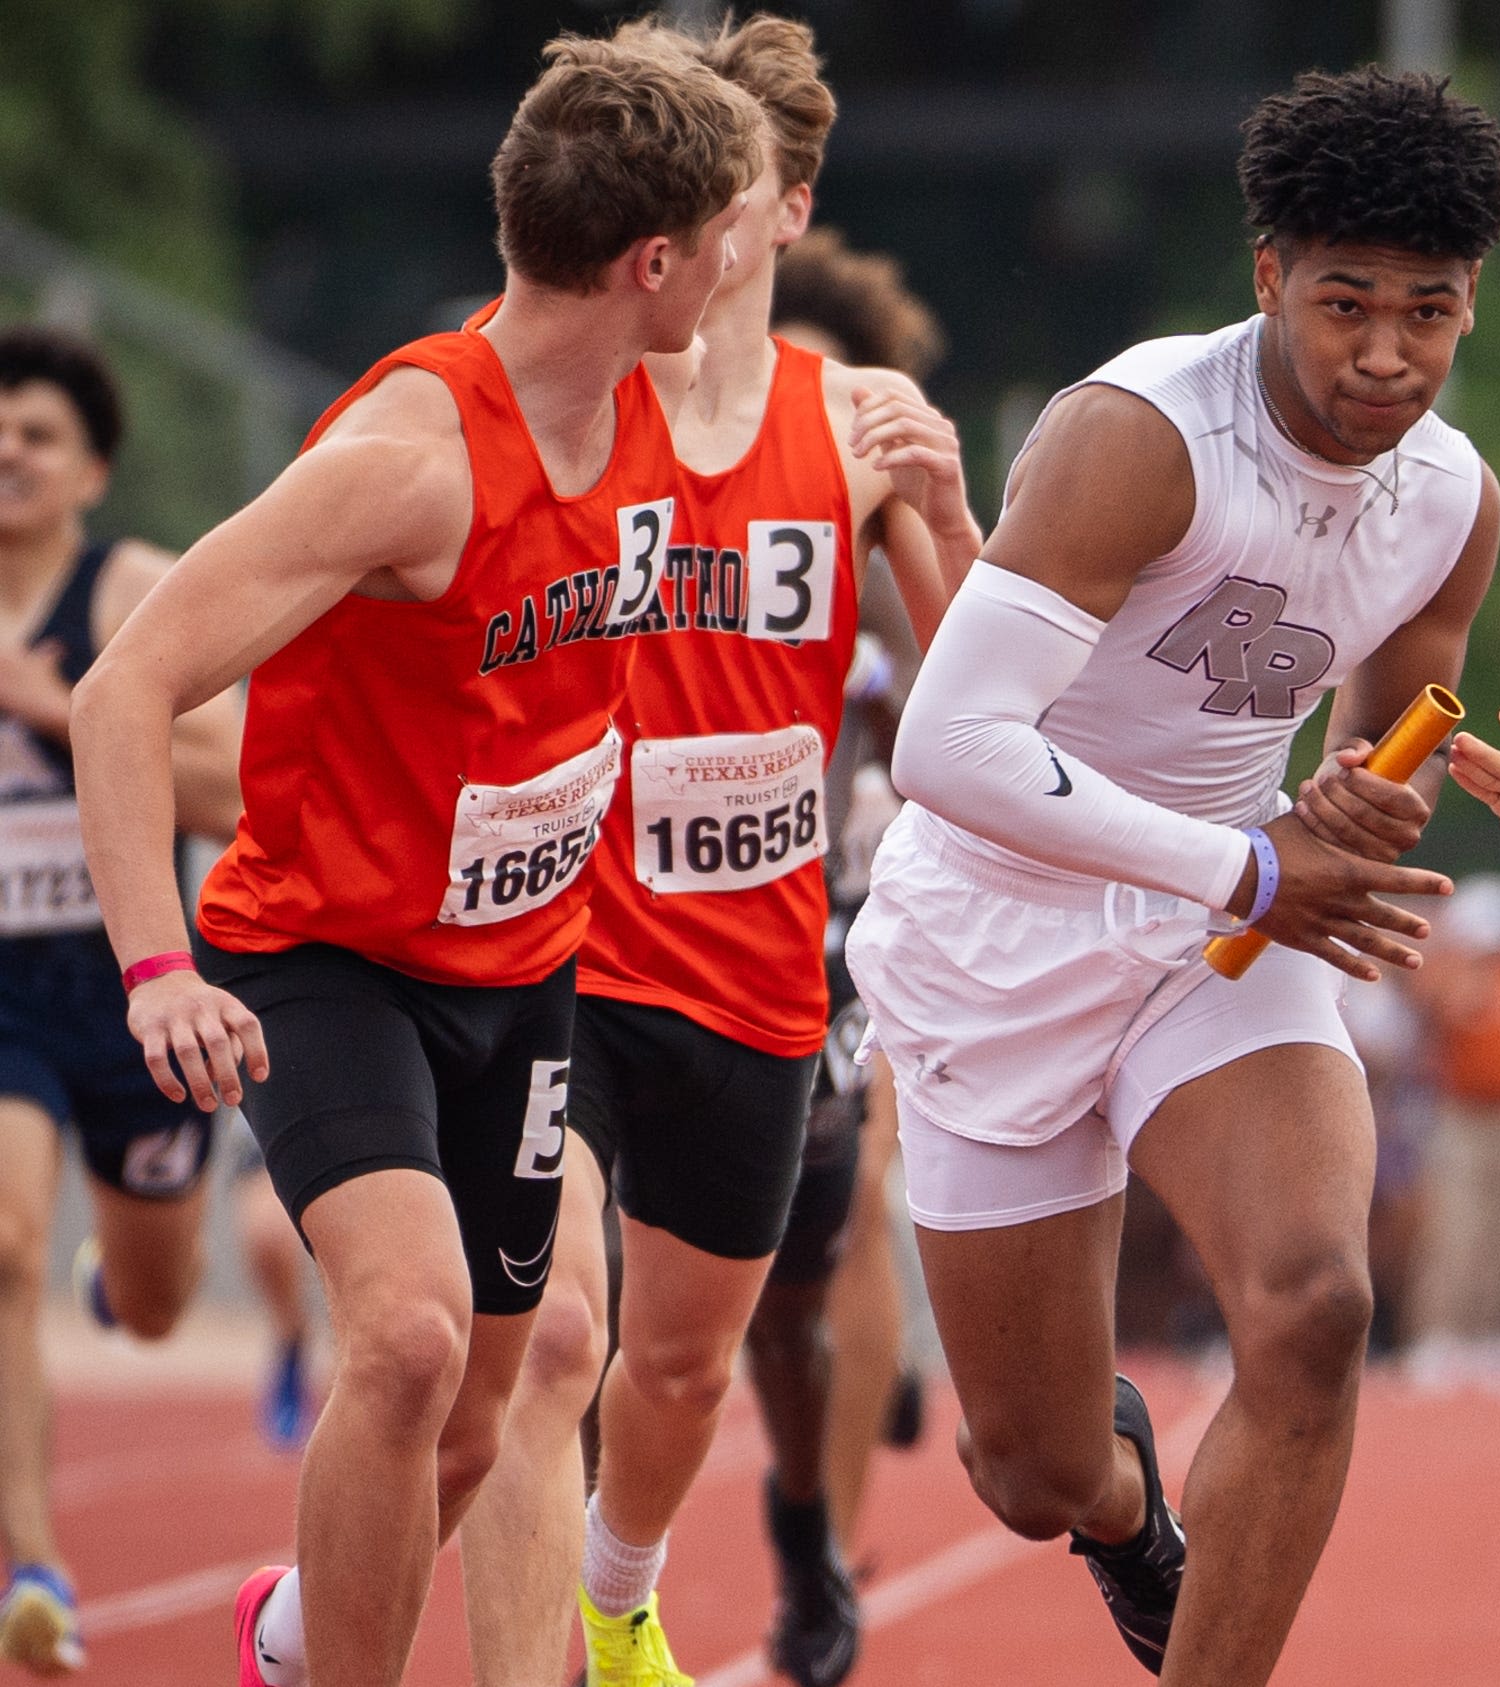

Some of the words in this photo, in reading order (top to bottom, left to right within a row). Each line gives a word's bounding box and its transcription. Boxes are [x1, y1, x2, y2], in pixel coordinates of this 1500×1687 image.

[619, 509, 660, 617] 3
[765, 527, 814, 633] 3
[478, 563, 640, 677] CATHO
[1146, 574, 1336, 719] RR
[685, 756, 736, 767] CLYDE
[686, 766, 758, 782] TEXAS
[763, 741, 819, 776] RELAYS
[505, 793, 567, 820] TEXAS
[507, 792, 552, 809] CLYDE
[723, 787, 780, 807] TRUIST
[532, 813, 580, 838] TRUIST
[647, 788, 817, 874] 16658
